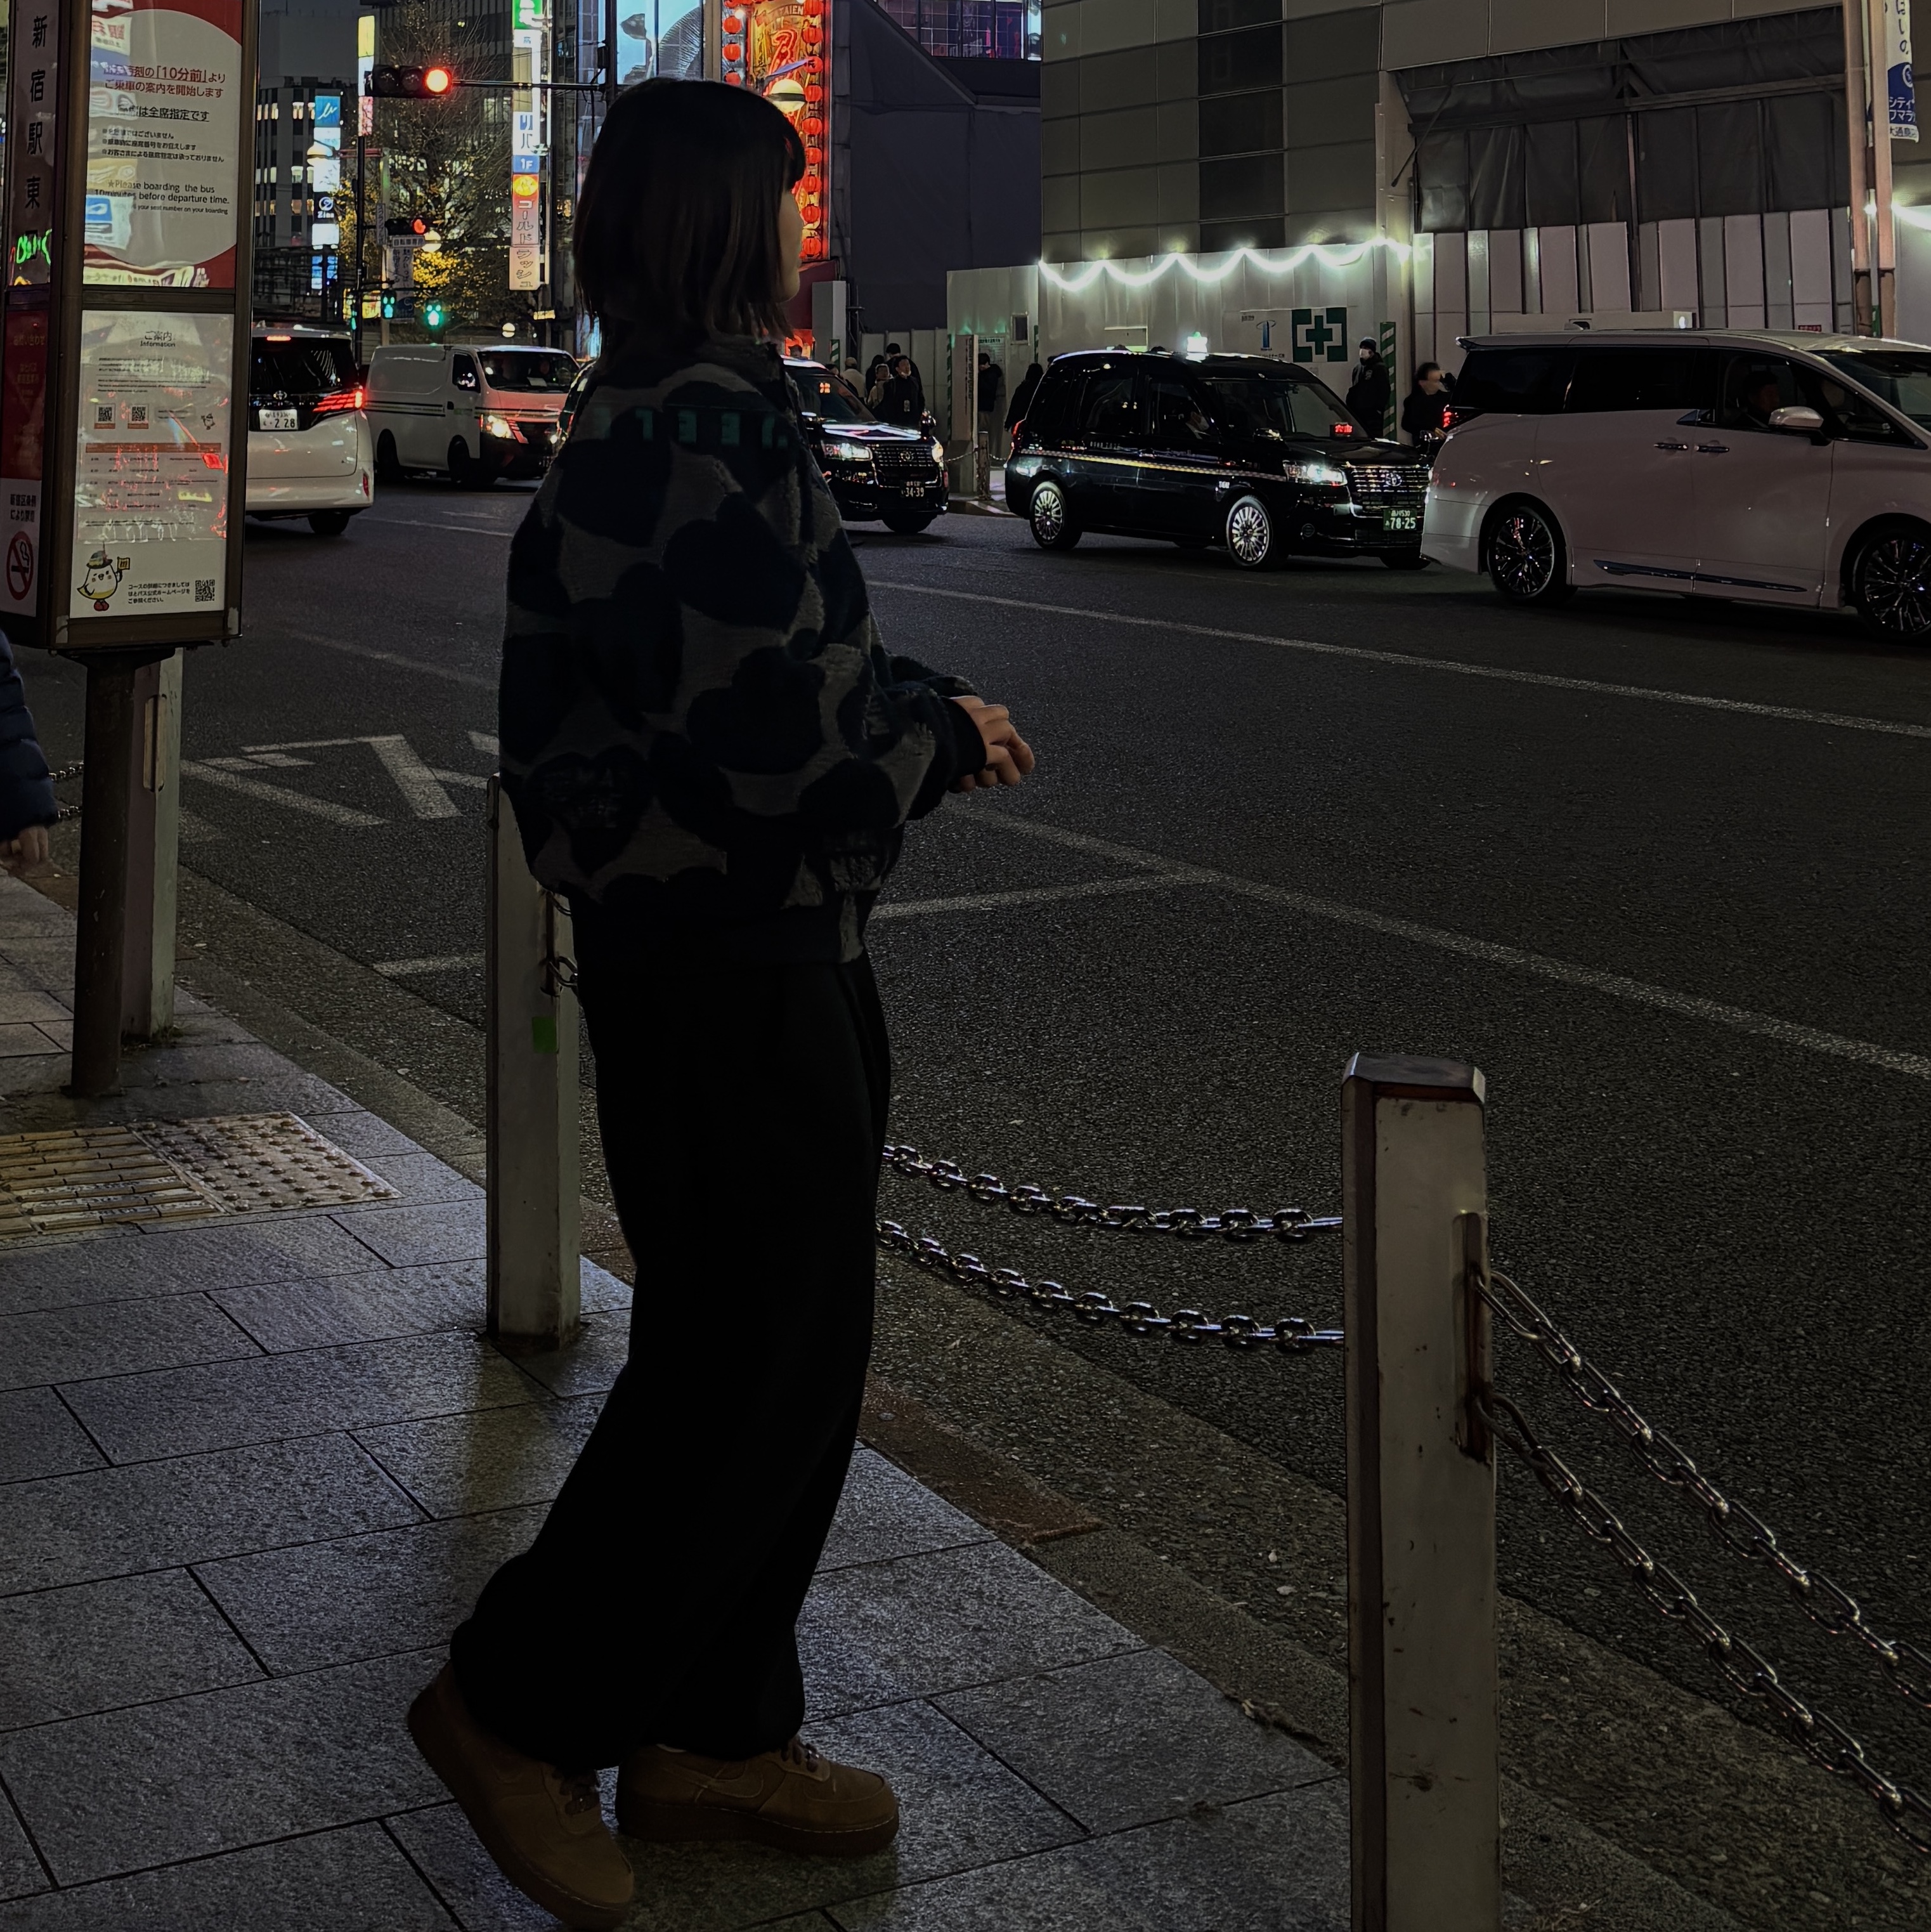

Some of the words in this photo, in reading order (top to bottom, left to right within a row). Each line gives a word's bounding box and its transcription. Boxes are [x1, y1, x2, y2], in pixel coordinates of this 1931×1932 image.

[521, 158, 533, 169] 1F
[144, 182, 179, 192] boarding
[185, 184, 197, 192] the
[200, 184, 214, 193] bus
[139, 192, 165, 201] before
[168, 193, 207, 204] departure
[210, 196, 230, 204] time.
